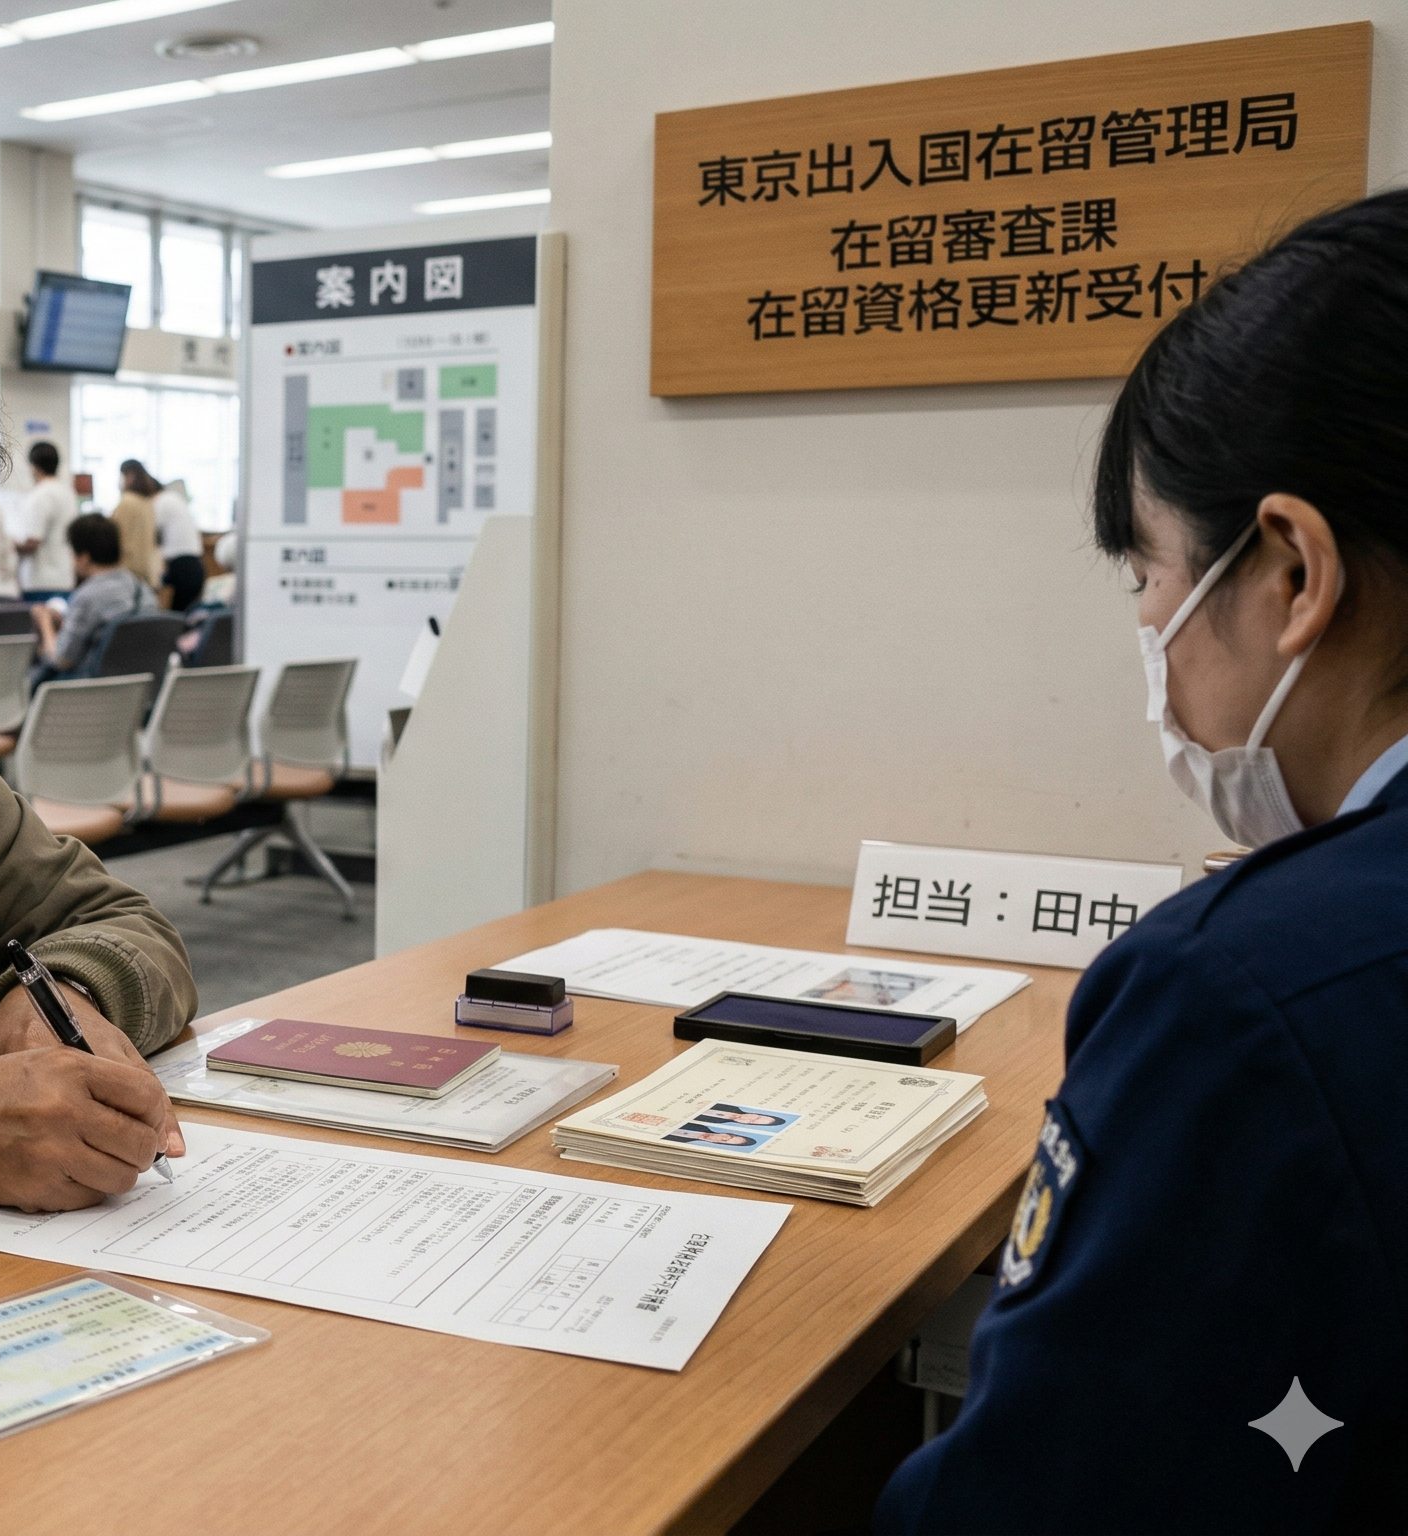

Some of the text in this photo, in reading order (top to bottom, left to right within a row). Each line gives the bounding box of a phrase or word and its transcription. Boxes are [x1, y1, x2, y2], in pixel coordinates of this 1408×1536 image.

[697, 92, 1300, 207] 東京出入国在留管理局
[830, 198, 1118, 272] 在留審査課
[315, 254, 464, 310] 案内図
[747, 259, 1208, 341] 在留資格更新受付
[872, 874, 1139, 940] 担当：田中
